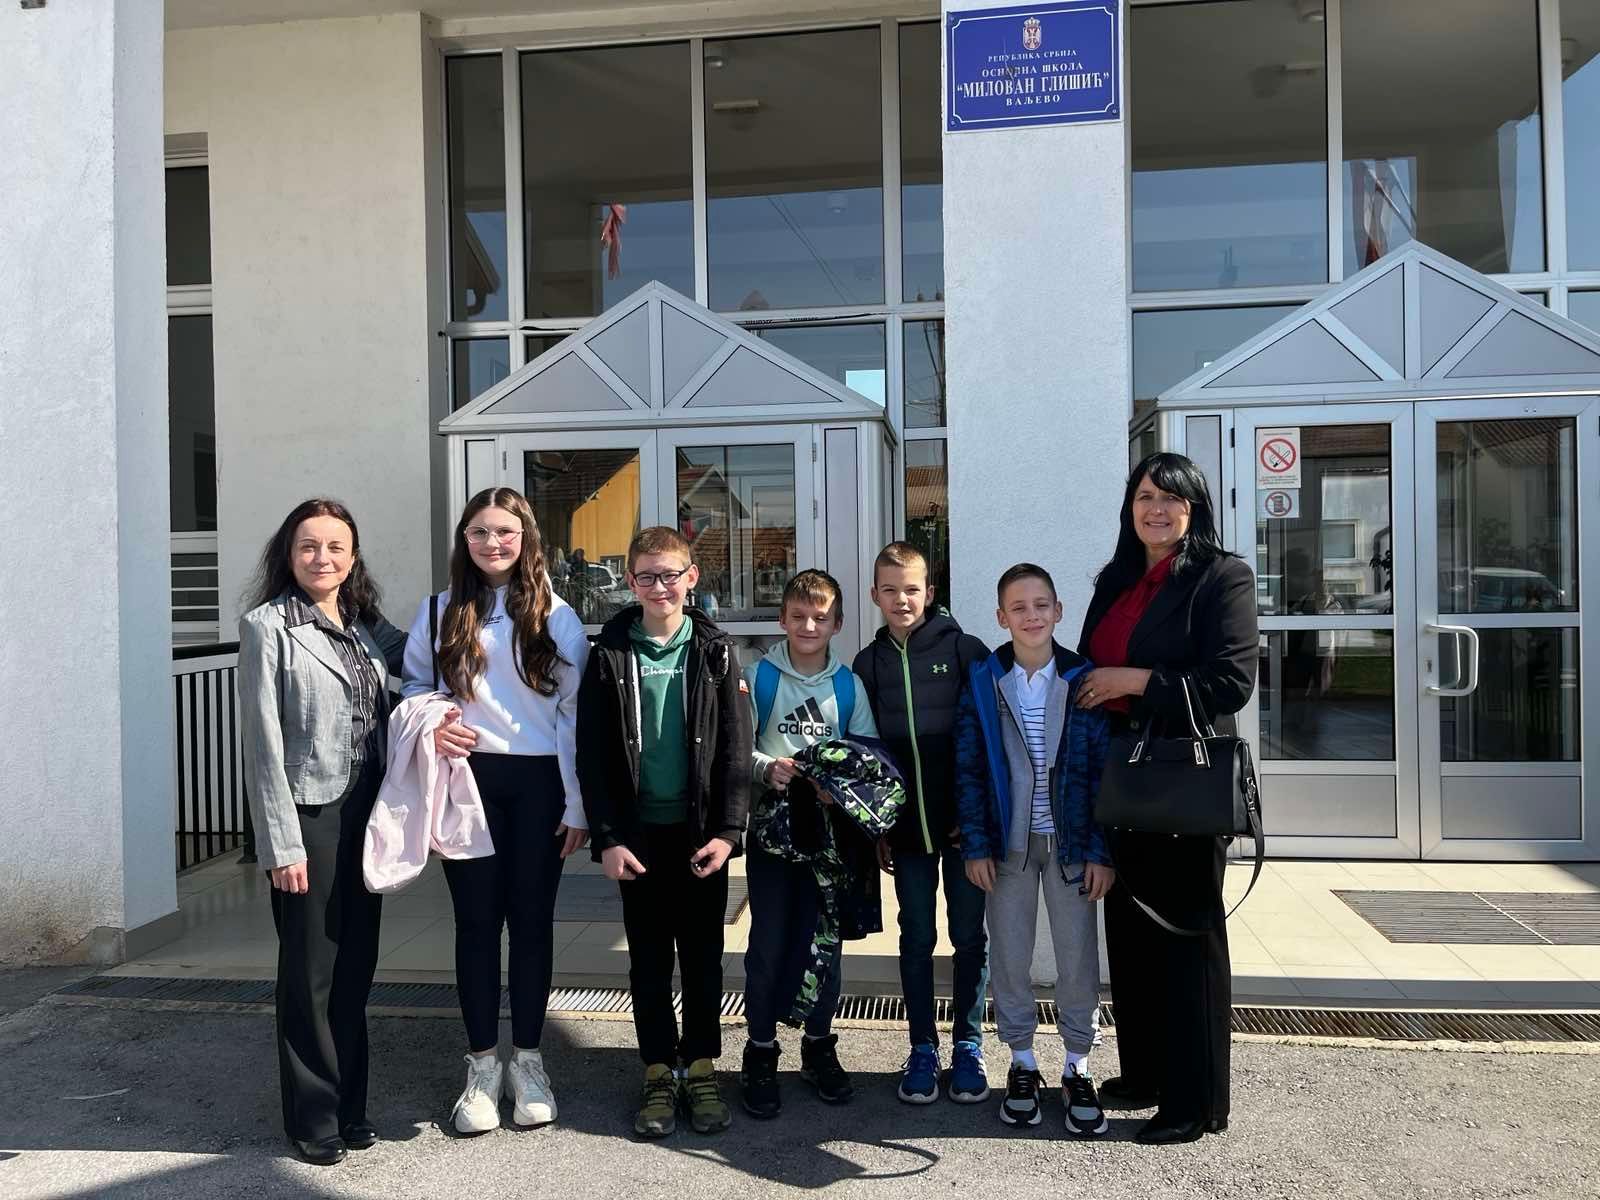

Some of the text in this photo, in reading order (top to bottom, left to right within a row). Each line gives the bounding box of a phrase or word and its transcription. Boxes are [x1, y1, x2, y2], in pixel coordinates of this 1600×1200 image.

[988, 50, 1077, 62] РЕПУБЛИКА СРБИЈА
[1042, 62, 1083, 73] ШКОЛА
[1006, 95, 1061, 106] ВАЉЕВО
[778, 721, 833, 737] adidas
